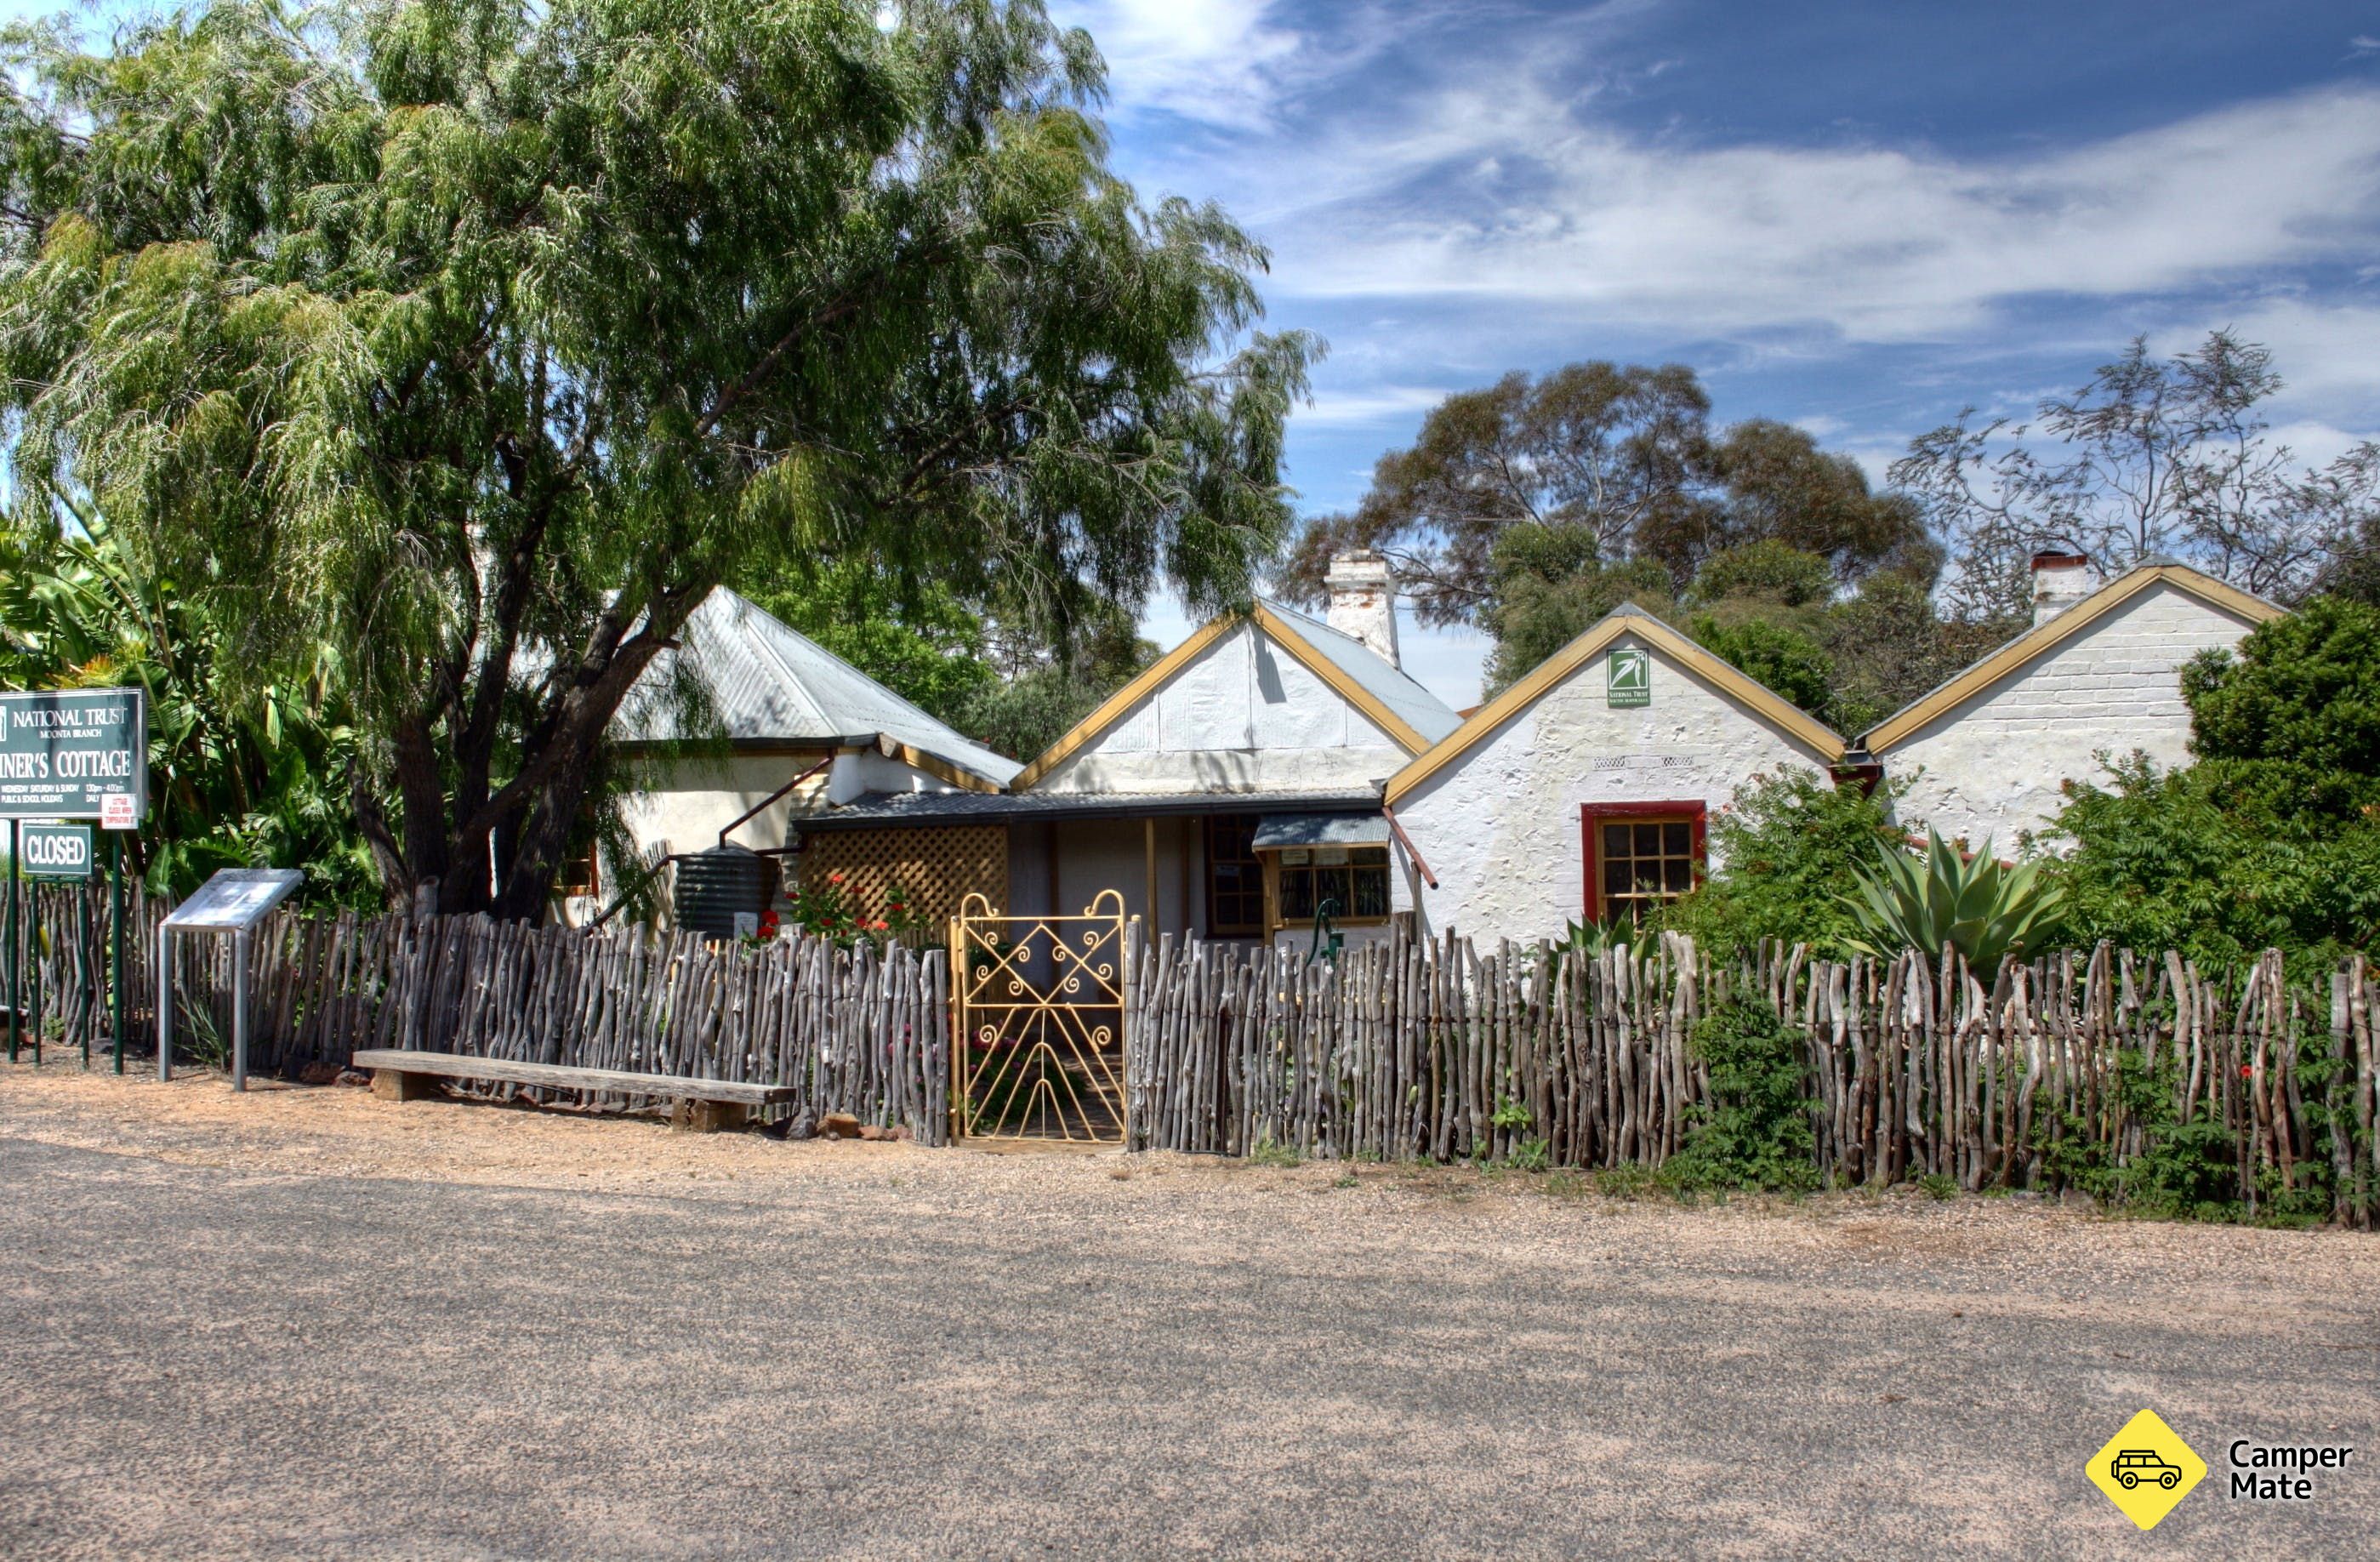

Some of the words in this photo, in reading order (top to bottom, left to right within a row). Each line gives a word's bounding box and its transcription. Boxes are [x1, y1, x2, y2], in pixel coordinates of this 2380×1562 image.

[14, 710, 83, 727] NATIONAL
[85, 706, 128, 726] TRUST
[41, 731, 71, 739] MOONTA
[73, 729, 102, 738] BRANCH
[57, 750, 130, 778] COTTAGE
[28, 835, 86, 864] CLOSED
